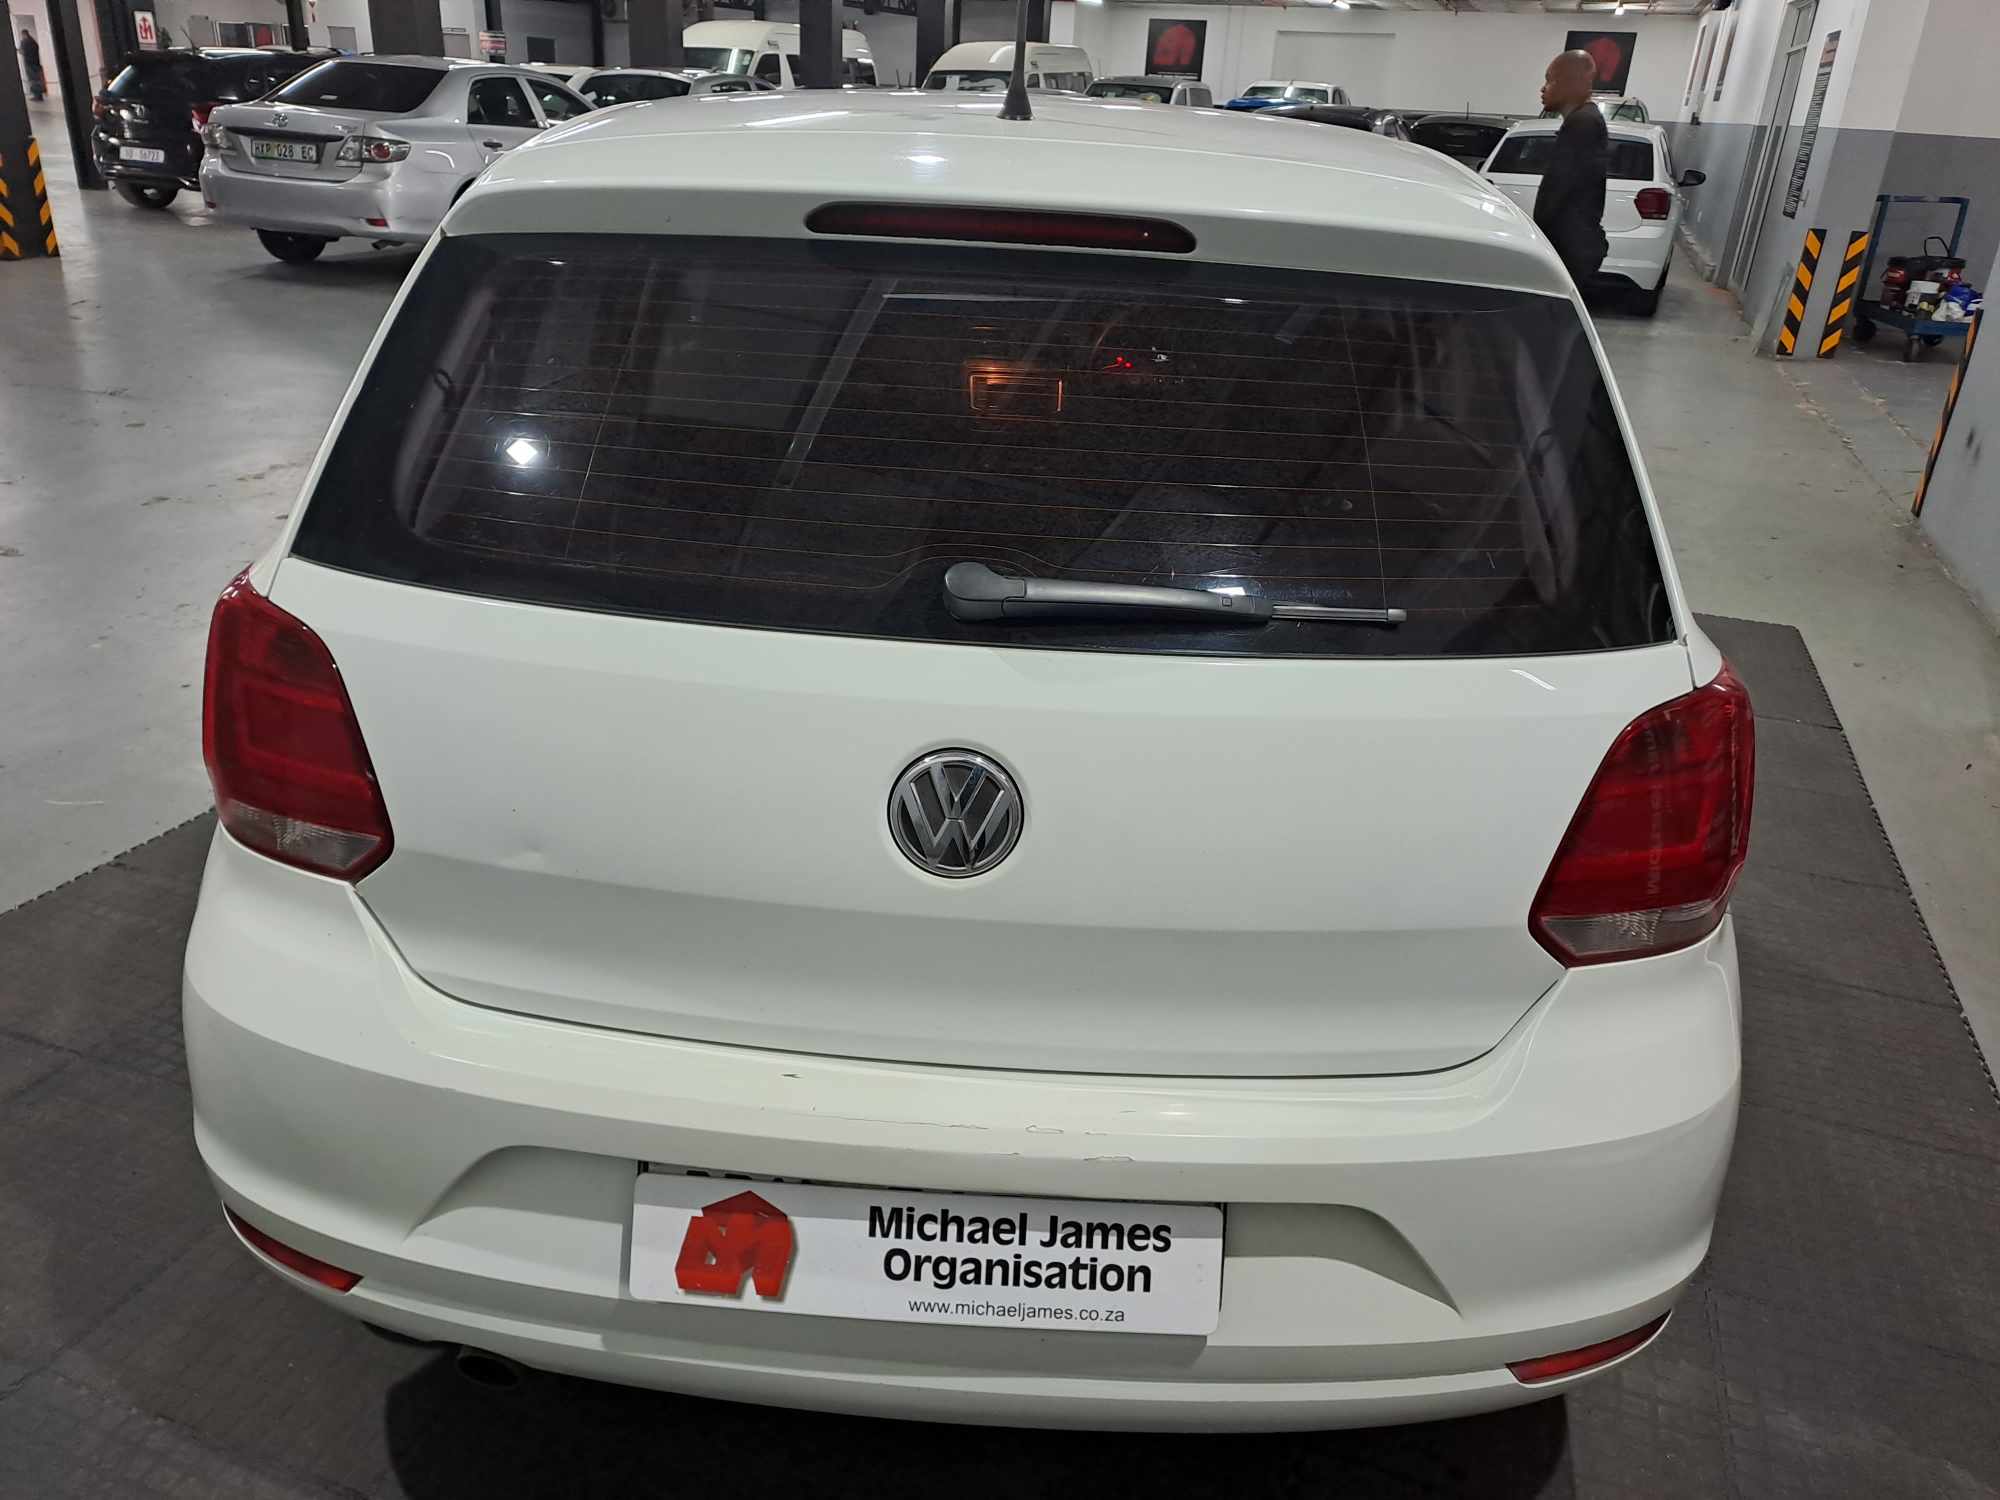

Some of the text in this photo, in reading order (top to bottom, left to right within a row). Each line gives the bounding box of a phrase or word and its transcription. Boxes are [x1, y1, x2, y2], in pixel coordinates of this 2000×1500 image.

[277, 143, 294, 158] 028
[301, 145, 314, 160] EC
[896, 757, 1015, 872] VW
[868, 1205, 1172, 1253] Michael James
[883, 1248, 1152, 1293] Organisation
[908, 1300, 1125, 1323] www.michaeljames.co.za
